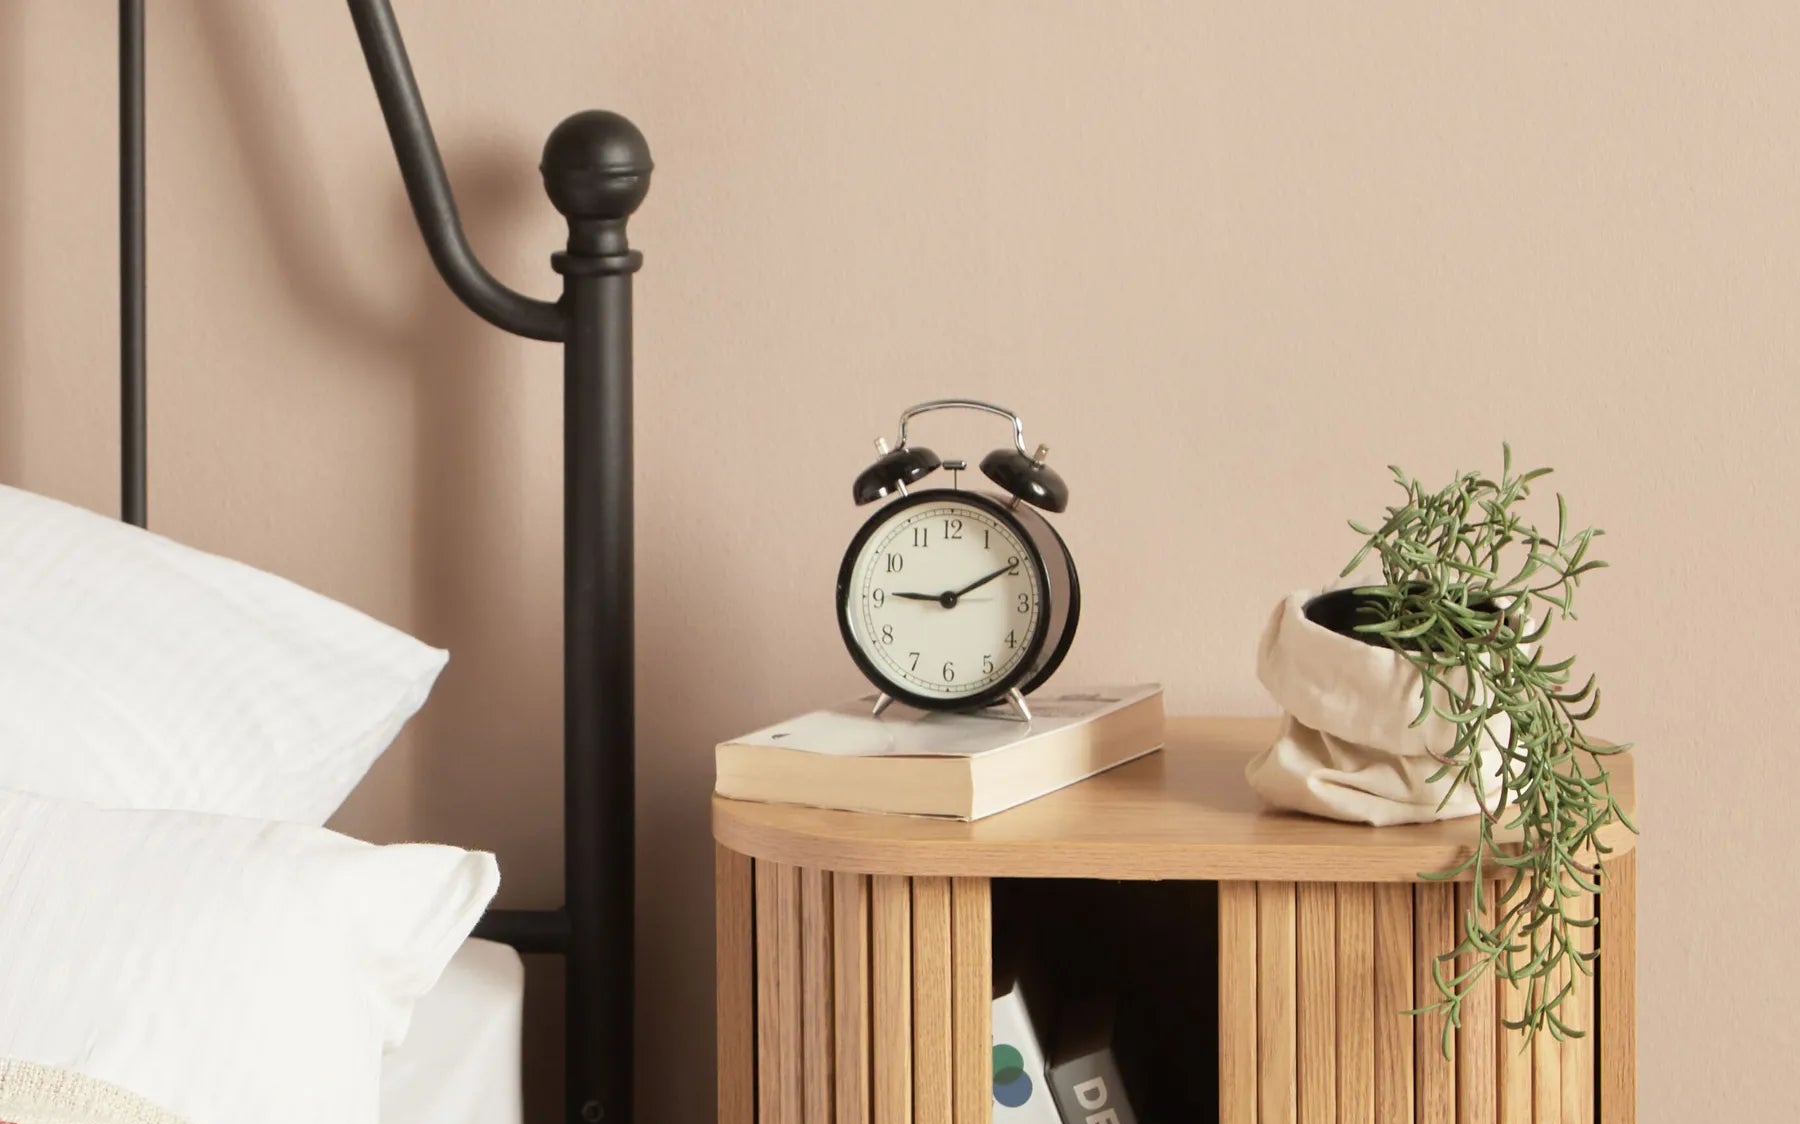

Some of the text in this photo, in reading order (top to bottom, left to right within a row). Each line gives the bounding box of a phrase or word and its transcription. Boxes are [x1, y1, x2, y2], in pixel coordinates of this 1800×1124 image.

[913, 527, 928, 548] 11
[944, 520, 963, 540] 12
[983, 529, 990, 549] 1
[886, 553, 904, 573] 10
[1007, 556, 1020, 576] 2
[872, 588, 885, 608] 9
[1017, 593, 1030, 613] 3
[881, 625, 894, 645] 8
[1004, 630, 1017, 649] 4
[908, 652, 920, 672] 7
[943, 662, 955, 682] 6
[982, 655, 994, 674] 5
